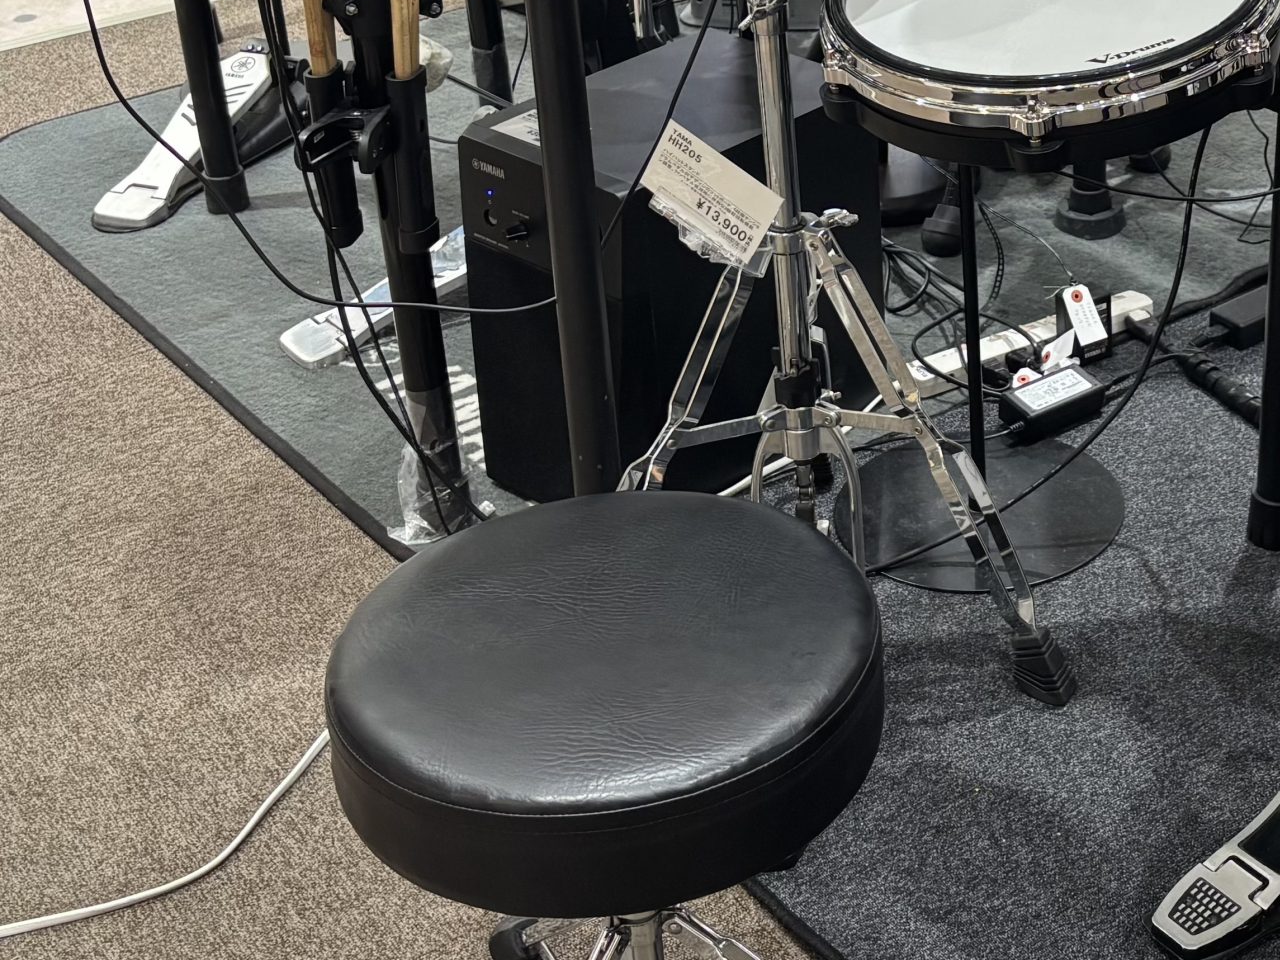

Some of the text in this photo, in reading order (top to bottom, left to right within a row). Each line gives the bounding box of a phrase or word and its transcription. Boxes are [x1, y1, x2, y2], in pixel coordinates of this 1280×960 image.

[668, 134, 703, 163] HH205
[672, 128, 693, 146] TAMA
[480, 161, 505, 179] YAMAHA
[696, 197, 748, 242] ¥13,900
